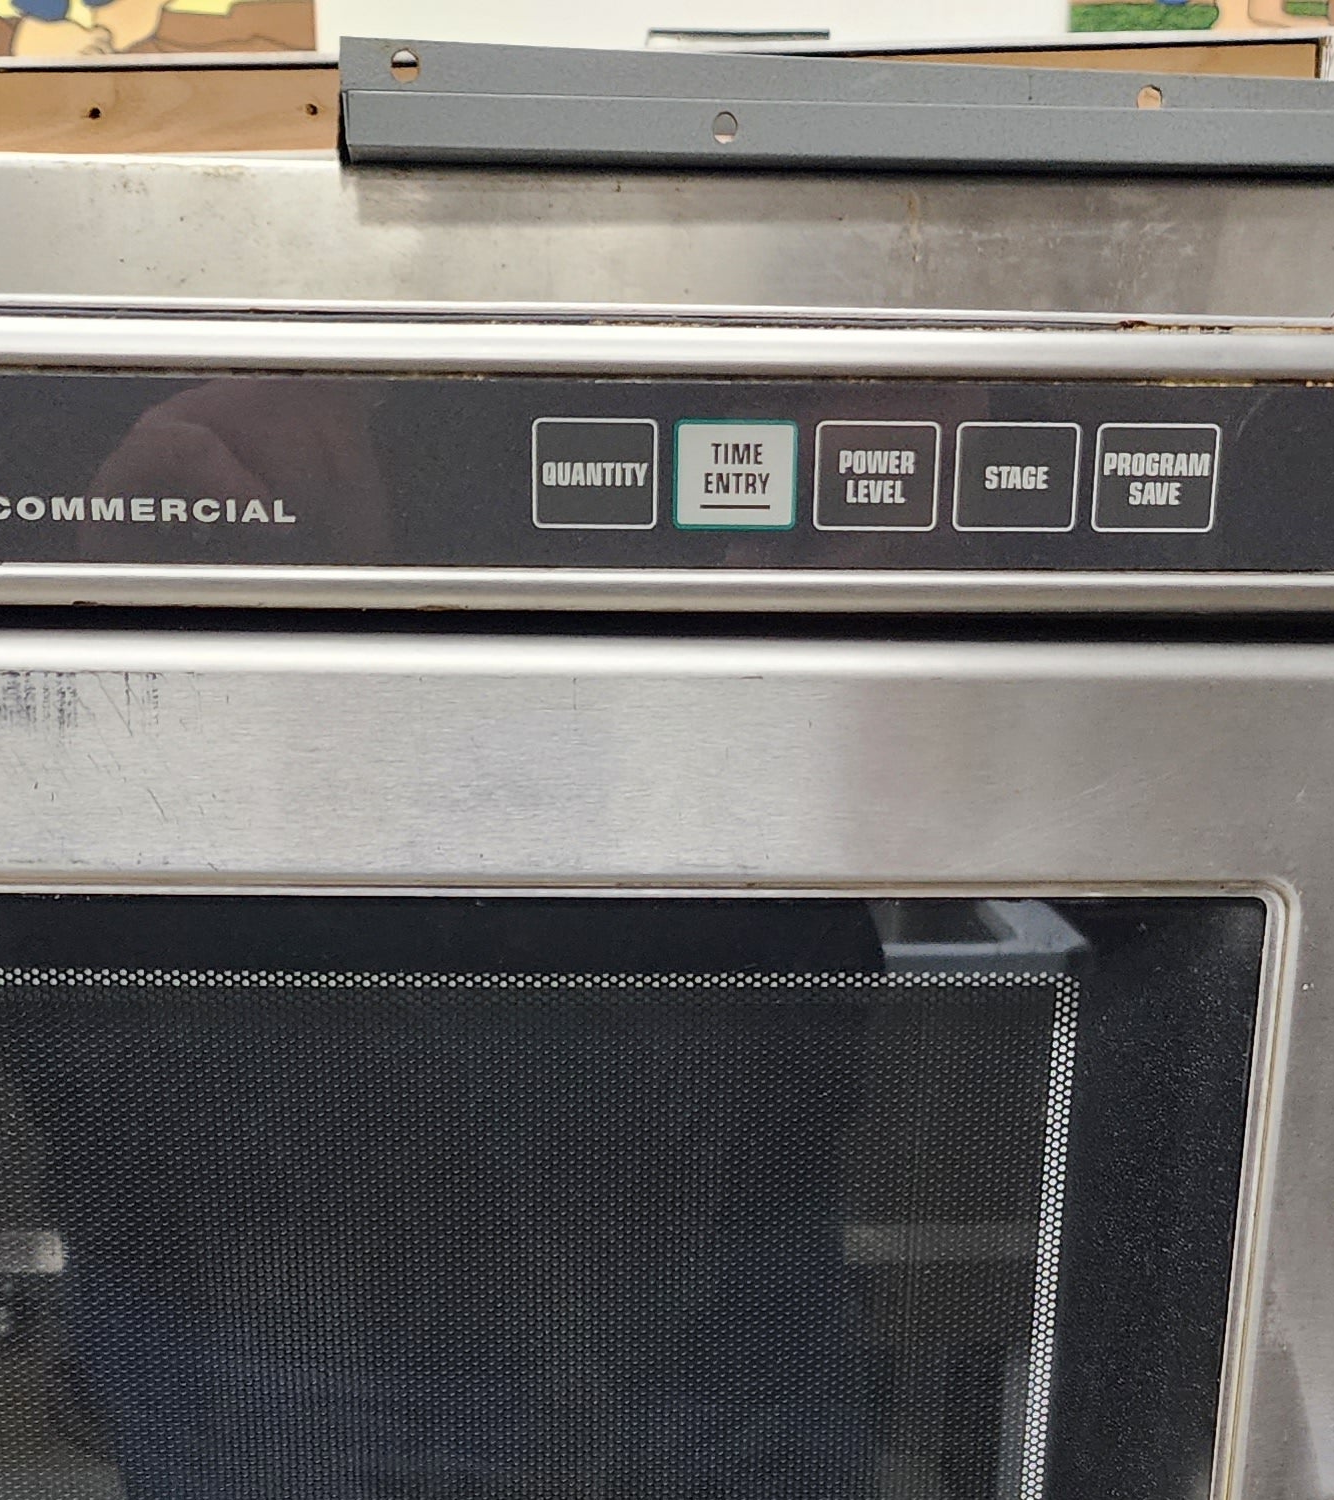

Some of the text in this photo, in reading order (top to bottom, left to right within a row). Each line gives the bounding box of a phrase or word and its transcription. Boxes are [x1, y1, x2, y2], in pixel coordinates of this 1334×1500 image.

[710, 441, 764, 466] TIME
[838, 450, 916, 476] POWER
[1103, 452, 1211, 477] PROGRAM
[541, 461, 648, 488] QUANTITY
[703, 471, 771, 496] ENTRY
[985, 465, 1049, 491] STAGE
[846, 479, 906, 504] LEVEL
[1128, 481, 1181, 506] SAVE
